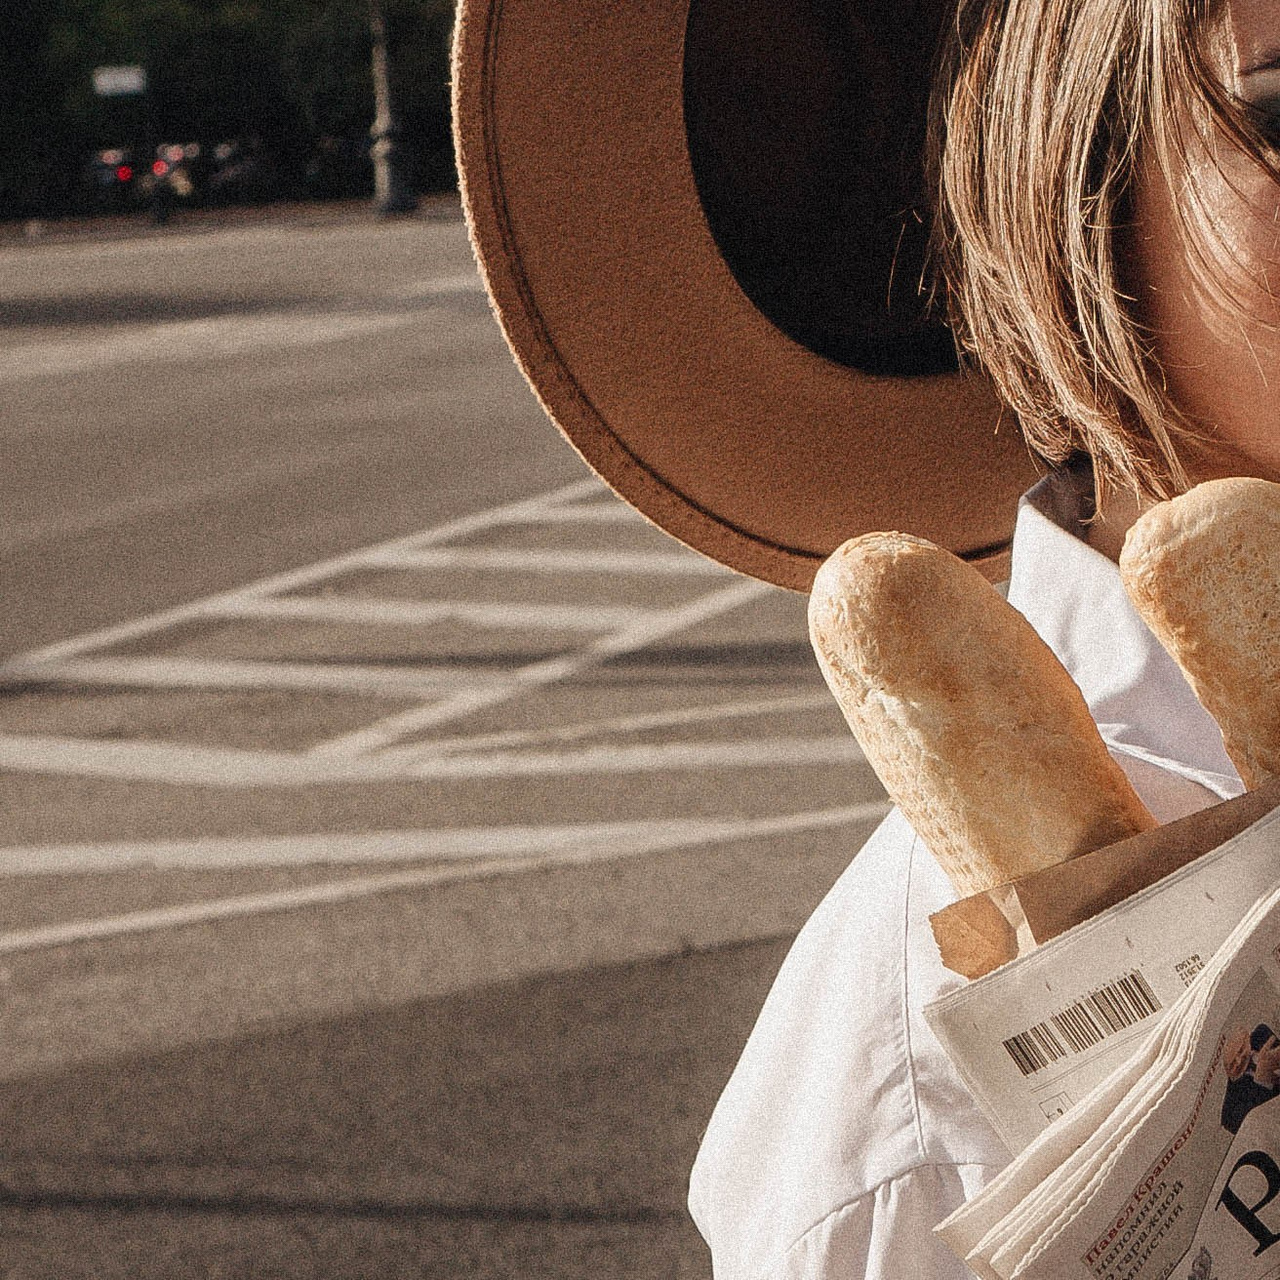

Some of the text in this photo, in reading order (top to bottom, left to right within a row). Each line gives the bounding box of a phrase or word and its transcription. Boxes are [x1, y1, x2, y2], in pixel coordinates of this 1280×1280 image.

[1085, 1206, 1135, 1266] Павел
[1095, 1181, 1168, 1276] напомнил
[1115, 1180, 1185, 1277] гаражной
